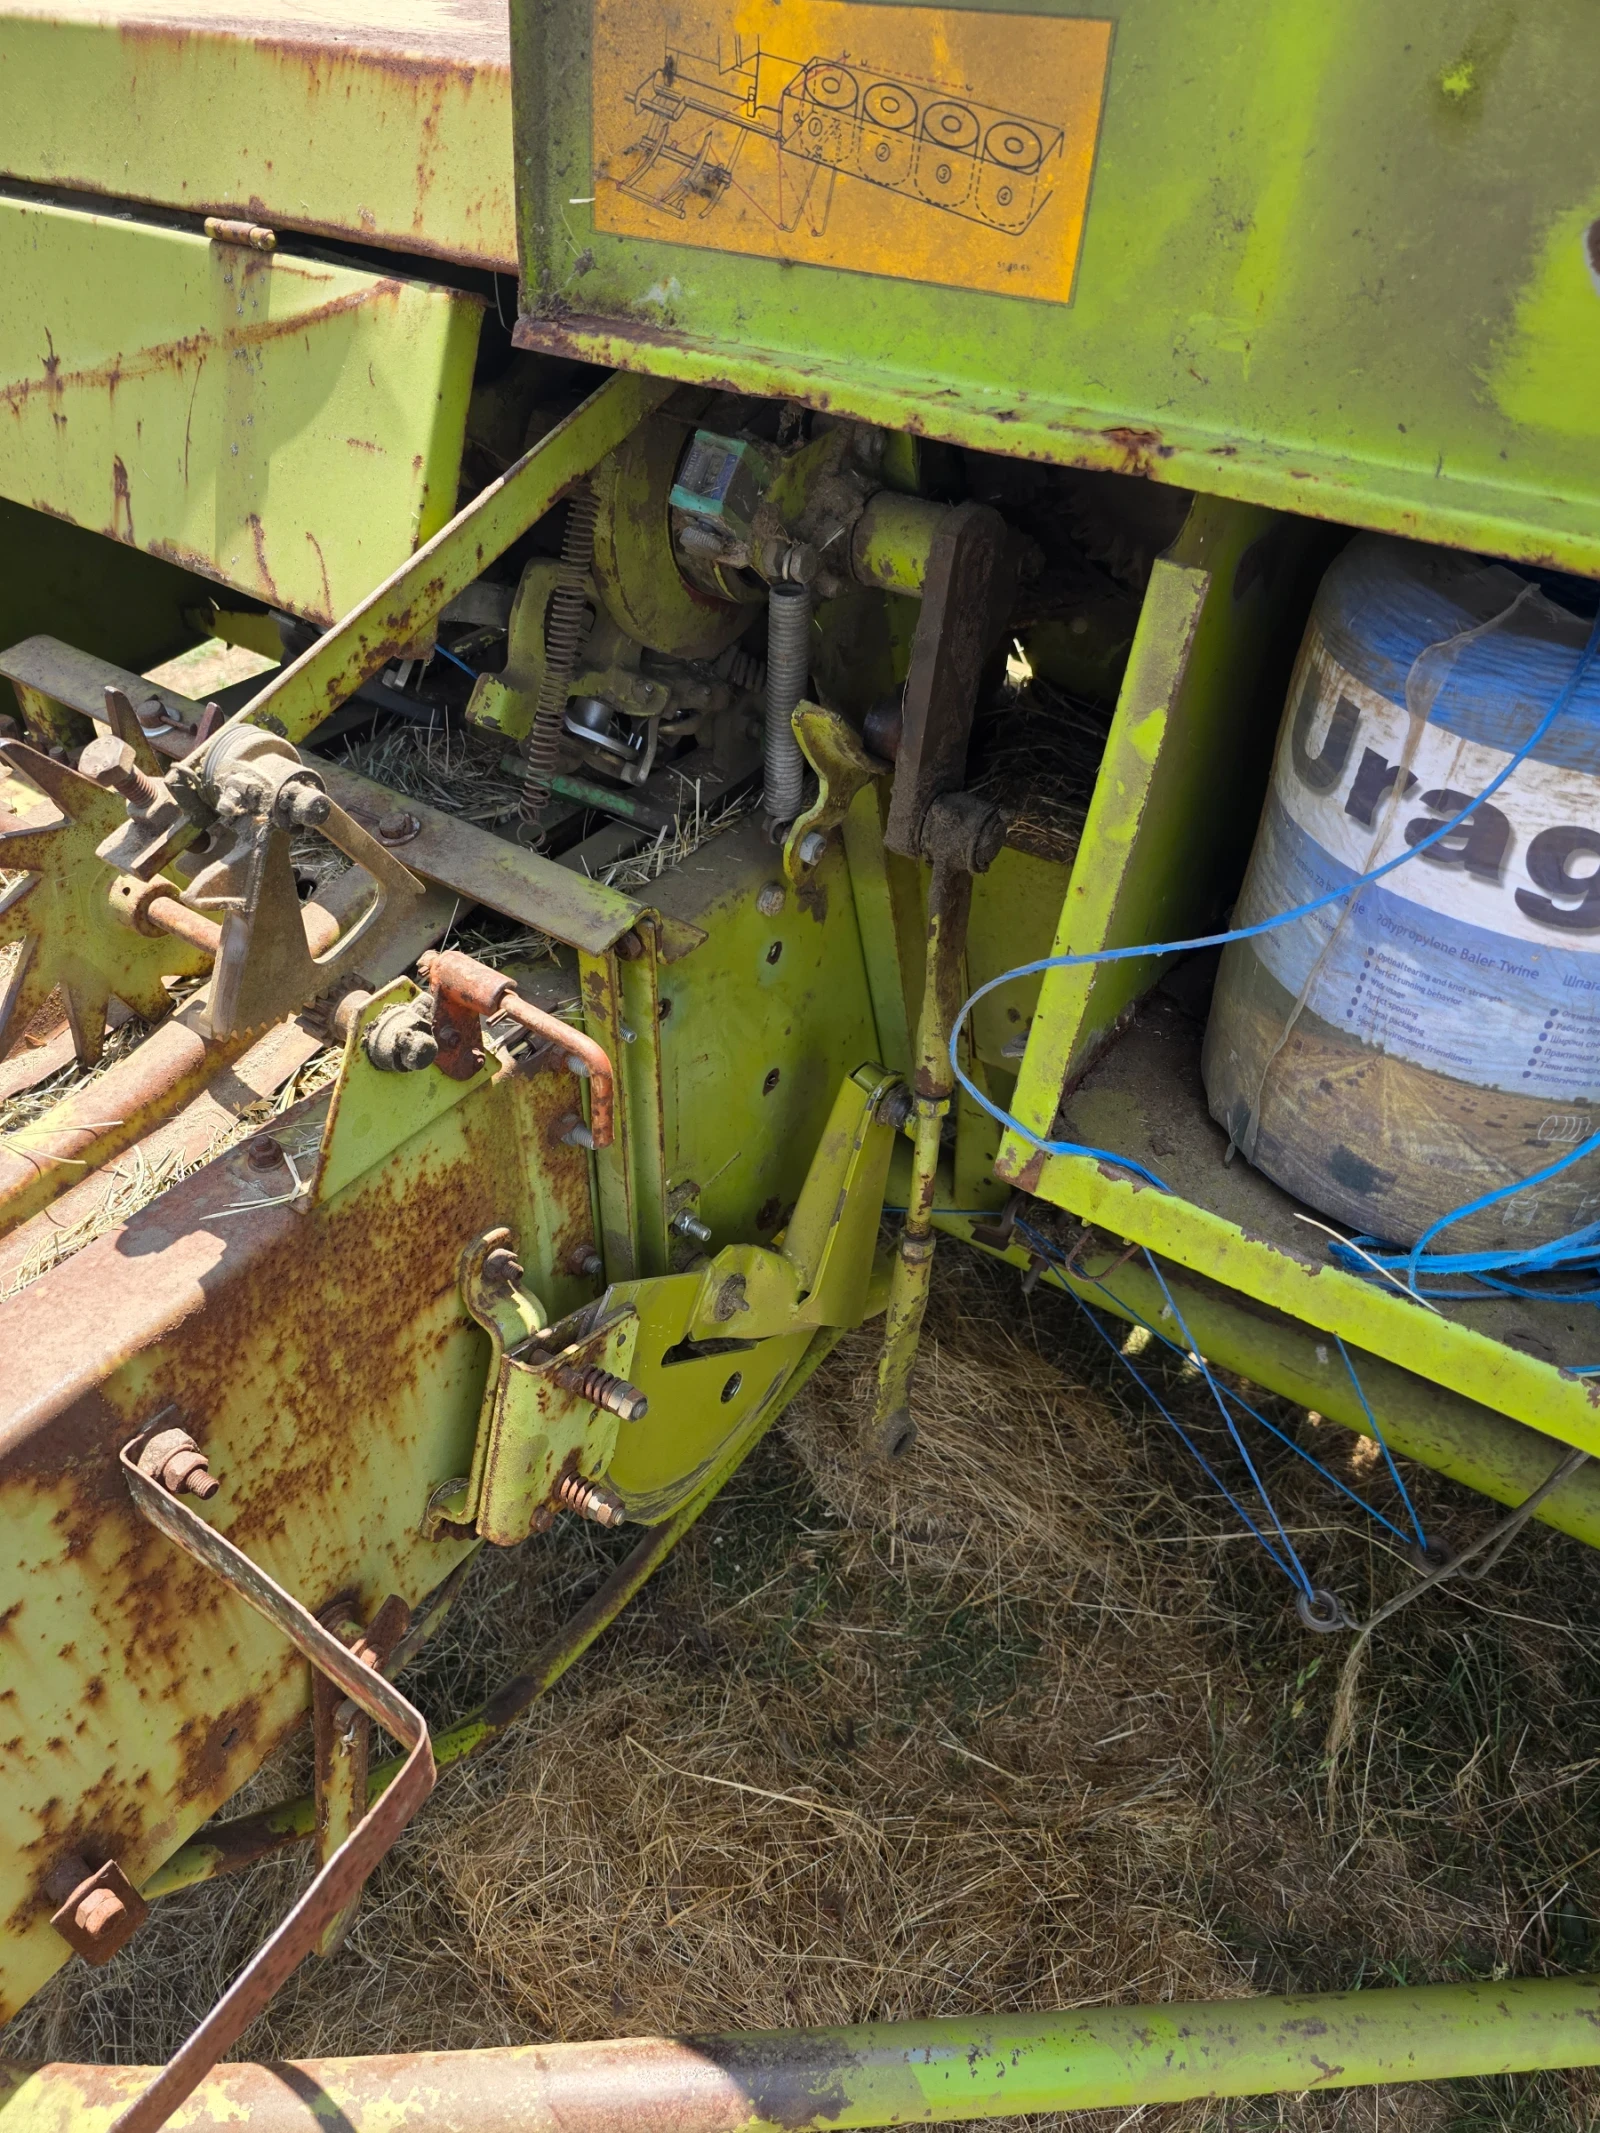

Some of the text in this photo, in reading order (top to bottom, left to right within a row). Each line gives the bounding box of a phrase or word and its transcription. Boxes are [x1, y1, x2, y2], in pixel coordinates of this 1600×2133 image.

[1460, 947, 1495, 968] Baler
[1500, 959, 1540, 980] Twine
[1374, 964, 1462, 1006] Perfct running behavior
[1385, 986, 1406, 999] usage
[1403, 963, 1431, 982] tearing
[1431, 976, 1447, 987] and
[1447, 981, 1466, 993] knot
[1467, 989, 1503, 1003] strength
[1362, 1002, 1425, 1037] Practcal packaging
[1366, 989, 1419, 1021] Perfct spooling
[1427, 1044, 1473, 1065] friendliness
